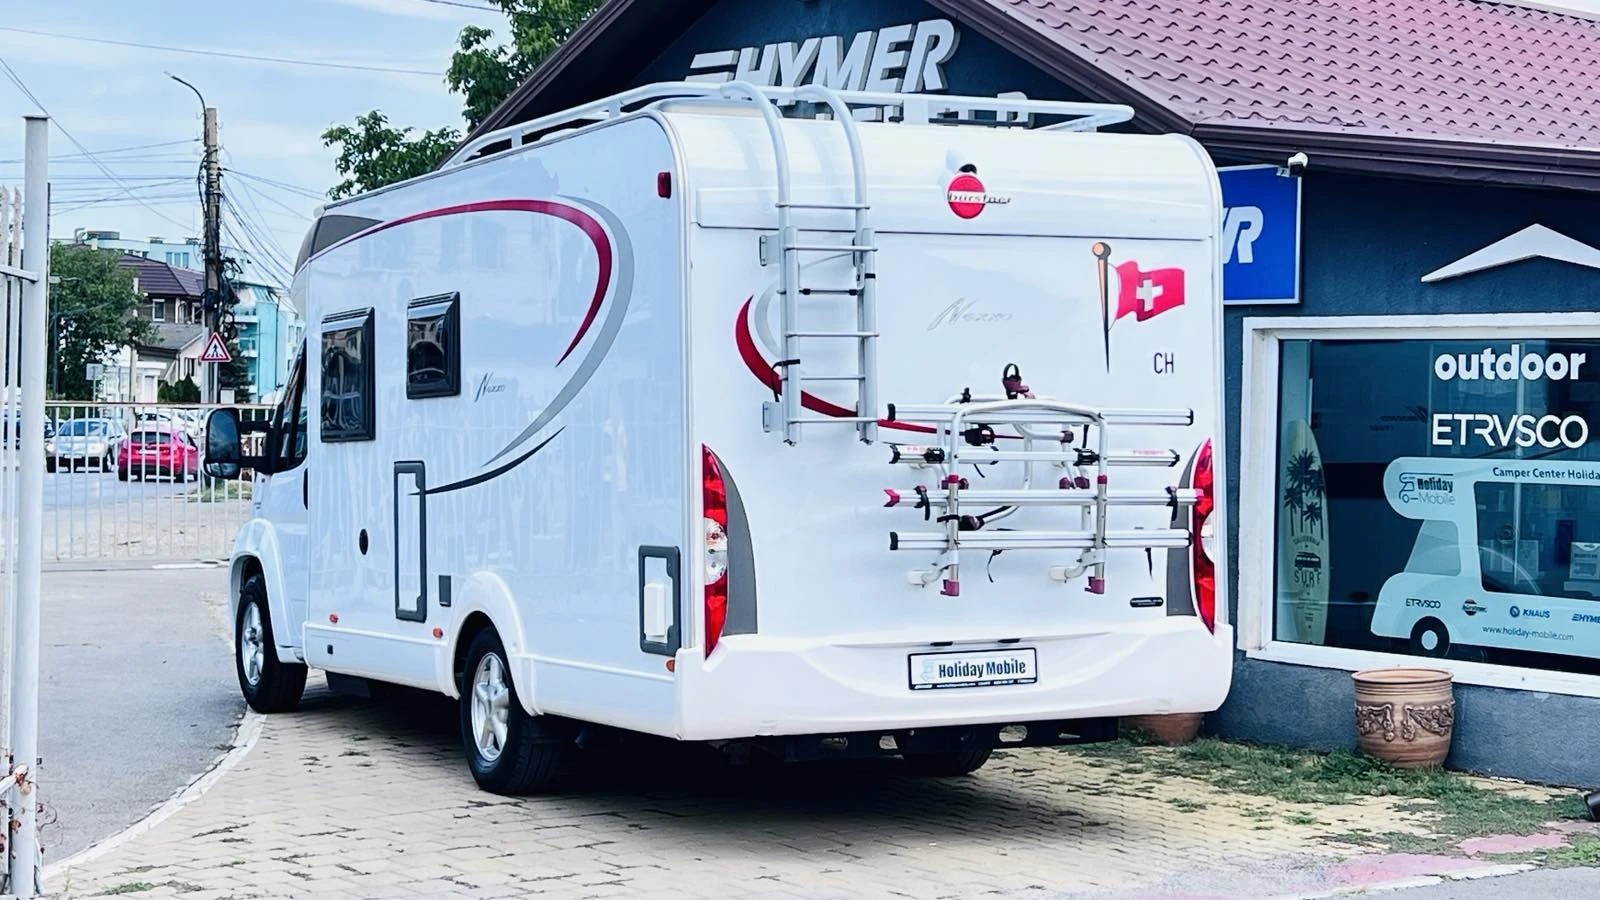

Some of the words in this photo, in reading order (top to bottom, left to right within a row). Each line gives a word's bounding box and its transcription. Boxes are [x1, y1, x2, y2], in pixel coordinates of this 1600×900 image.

[1153, 352, 1175, 374] CH
[1434, 343, 1587, 381] outdoor
[1492, 467, 1530, 479] Camper
[1532, 468, 1566, 479] Center
[1417, 477, 1454, 493] Holiday
[1418, 492, 1456, 505] Mobile
[1294, 570, 1321, 584] SURF
[1522, 608, 1551, 618] KNAUS
[1481, 626, 1574, 641] www.holiday-mobile.com
[938, 661, 984, 679] Holiday
[986, 658, 1026, 676] Mobile
